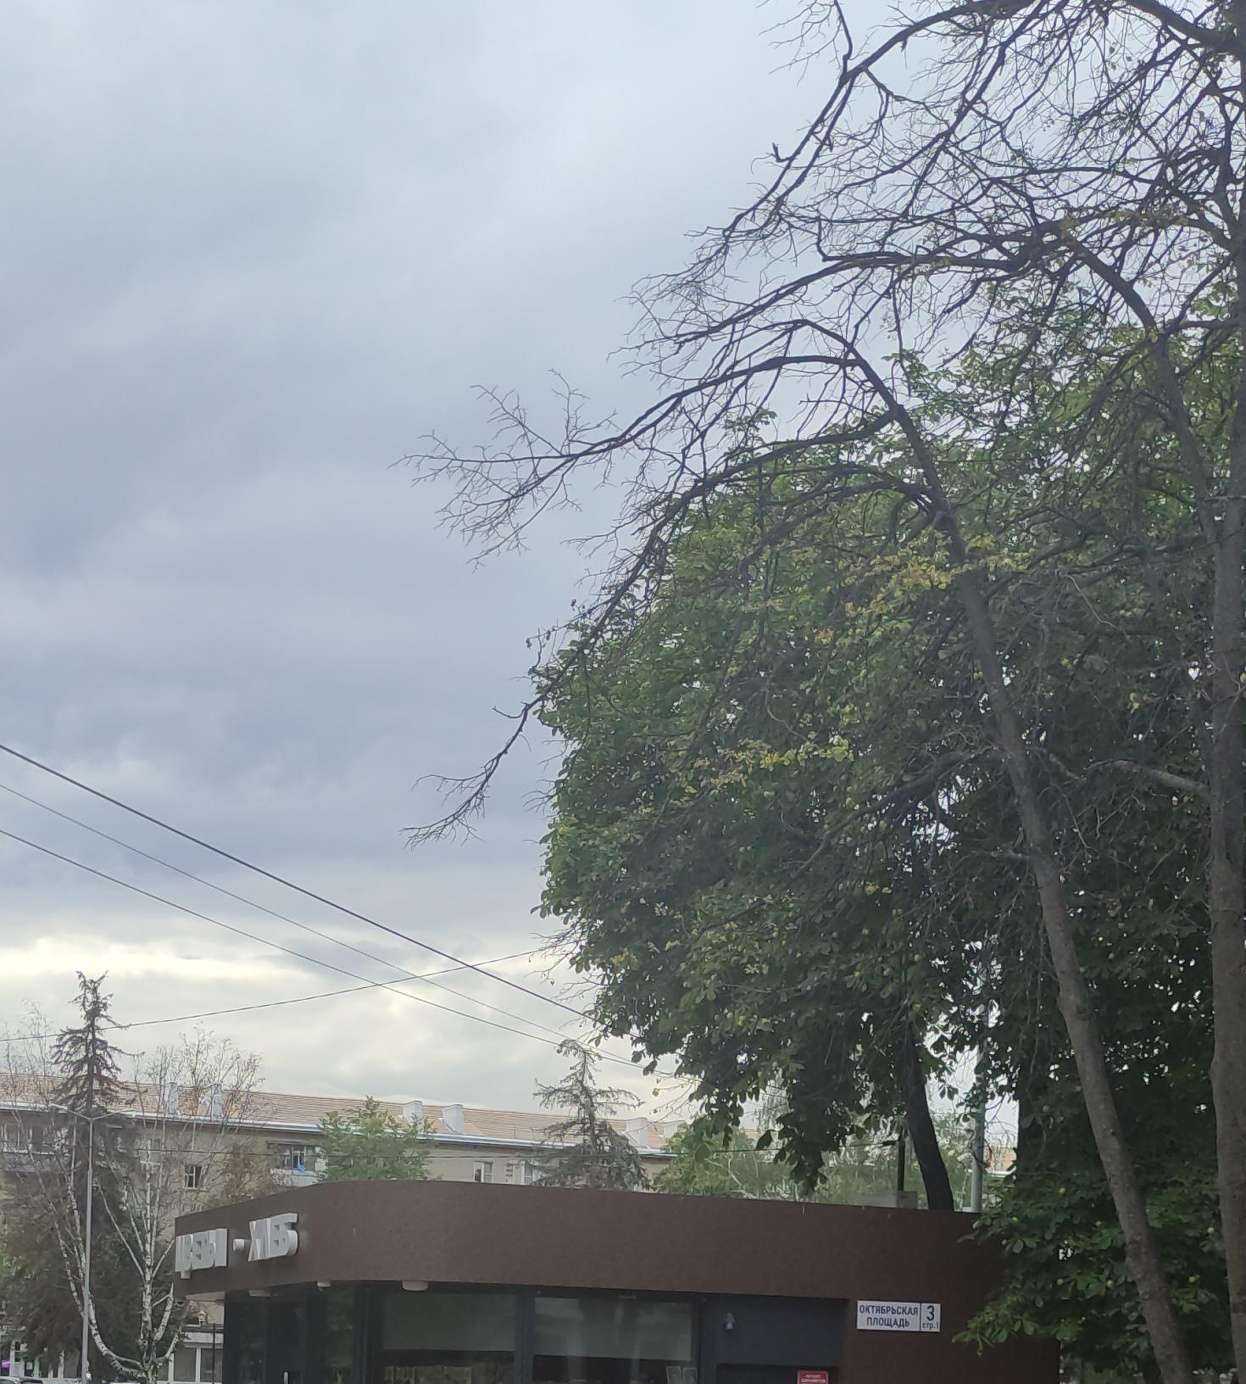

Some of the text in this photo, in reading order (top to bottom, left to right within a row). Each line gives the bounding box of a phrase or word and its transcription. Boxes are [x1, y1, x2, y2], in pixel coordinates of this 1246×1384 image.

[248, 1212, 299, 1262] ХЛЕБ
[859, 1304, 919, 1316] ОКТЯБРЬСКАЯ
[926, 1305, 935, 1321] 3
[866, 1316, 910, 1328] ПЛОЩАДЬ
